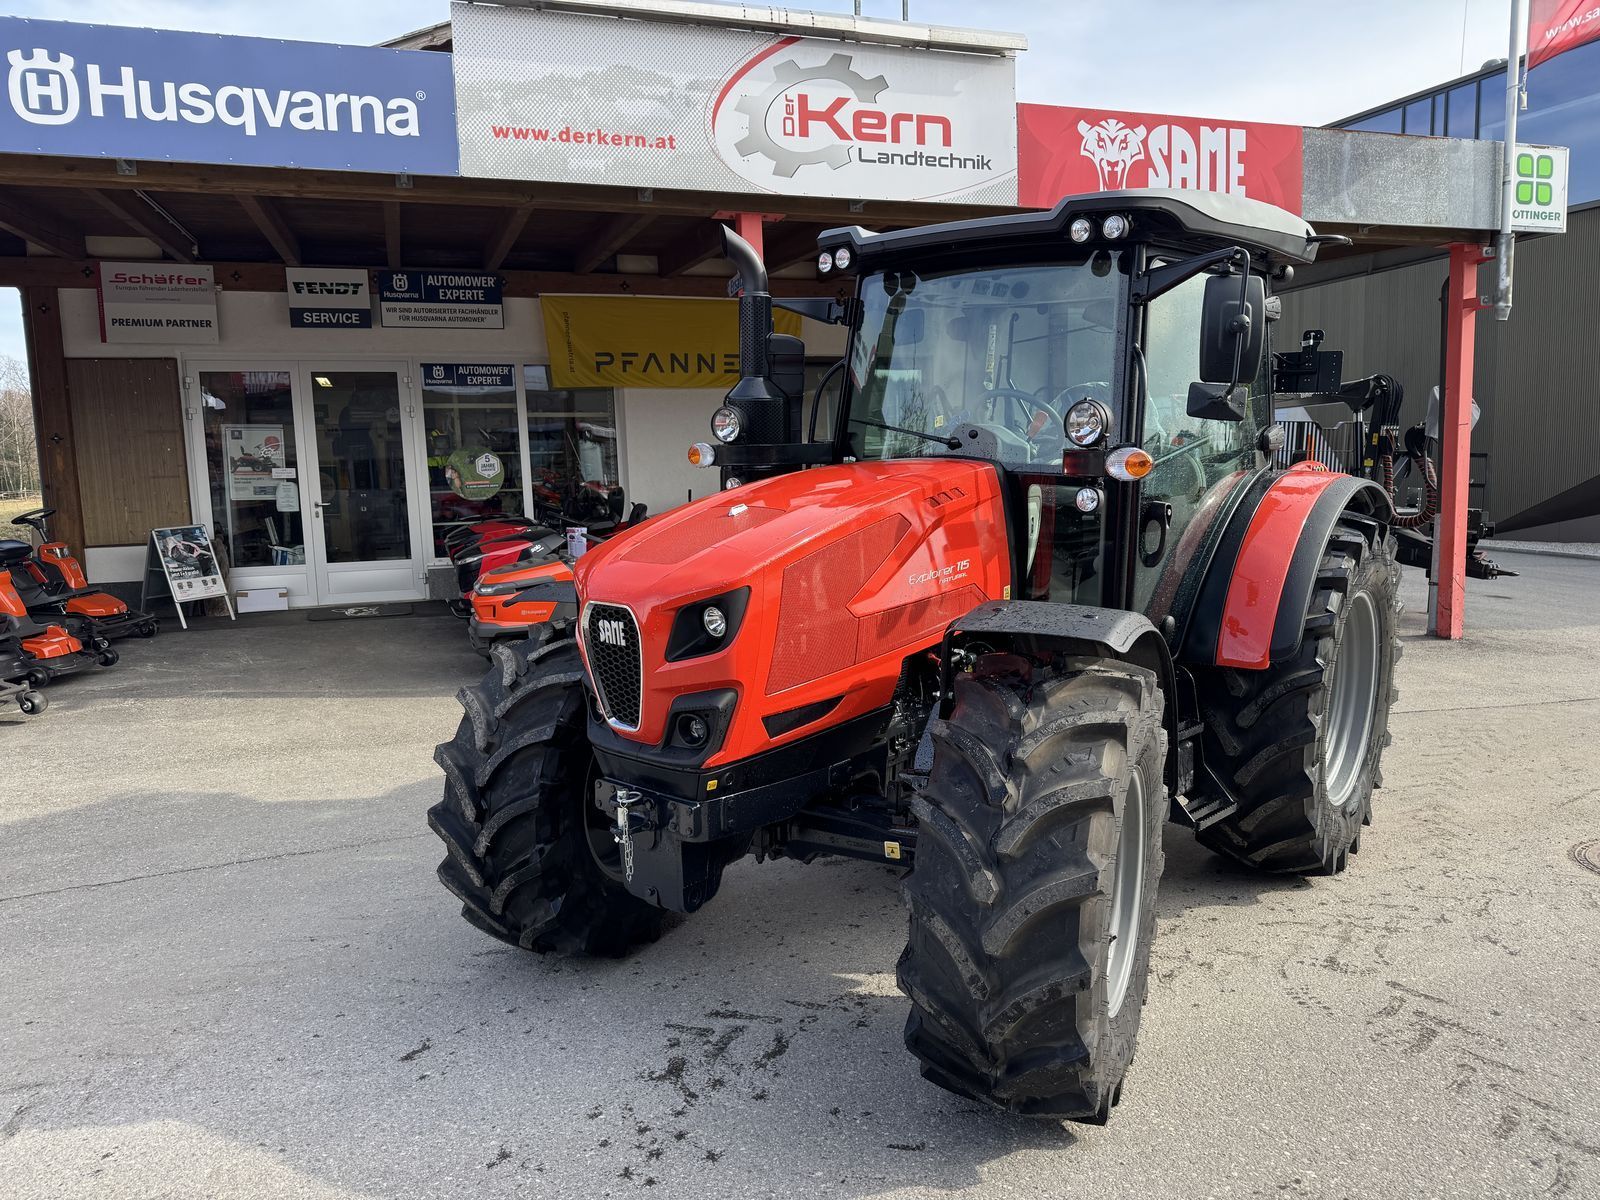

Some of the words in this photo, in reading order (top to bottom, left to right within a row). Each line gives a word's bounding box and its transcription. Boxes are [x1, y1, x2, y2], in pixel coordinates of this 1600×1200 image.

[798, 93, 952, 147] Kern
[491, 122, 677, 151] www.derkern.at
[858, 146, 993, 171] Landtechnik
[1147, 124, 1247, 197] SAME
[109, 273, 208, 286] Schäffer
[292, 281, 363, 296] FENDT
[383, 290, 419, 300] Husqvarna
[439, 288, 485, 301] EXPERTE
[303, 312, 361, 325] SERVICE
[458, 308, 499, 316] FACHHÄNDLER
[111, 318, 164, 328] PREMIUM
[166, 319, 213, 329] PARTNER
[467, 376, 502, 385] EXPERTE
[485, 455, 491, 463] 5
[909, 565, 956, 585] Explorer
[956, 560, 970, 572] 115
[598, 619, 626, 646] SAME
